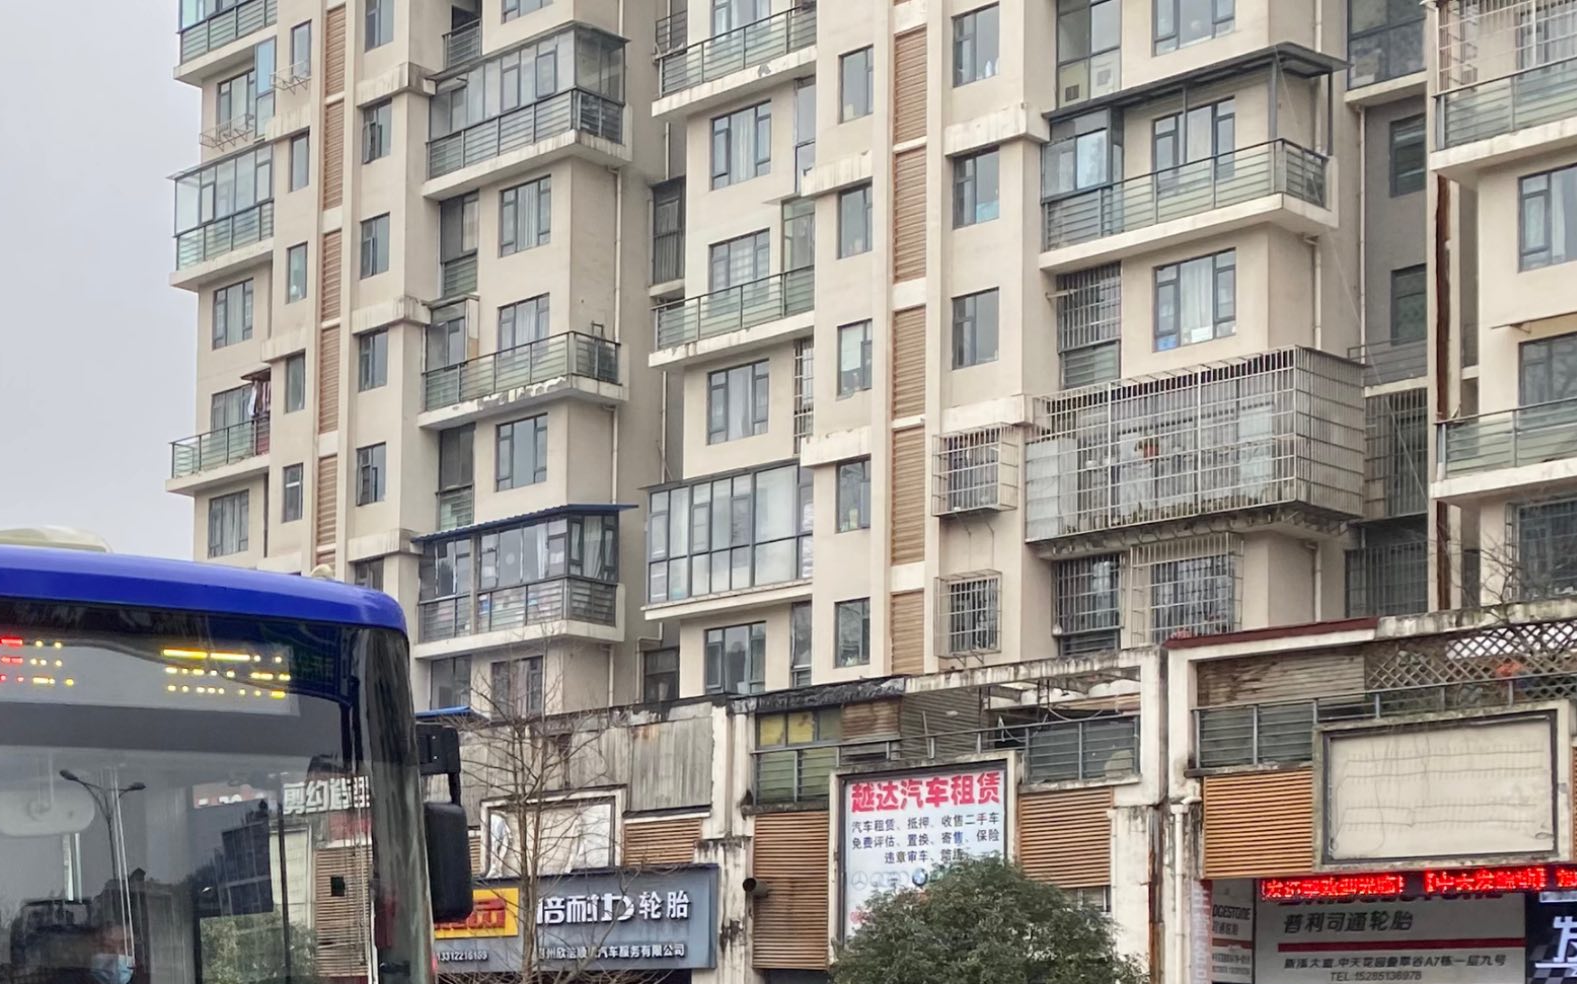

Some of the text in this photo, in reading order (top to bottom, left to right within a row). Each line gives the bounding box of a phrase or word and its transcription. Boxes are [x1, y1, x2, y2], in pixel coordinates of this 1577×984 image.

[851, 772, 1001, 812] 越达汽车租赁
[1284, 911, 1413, 934] 普利司通轮胎
